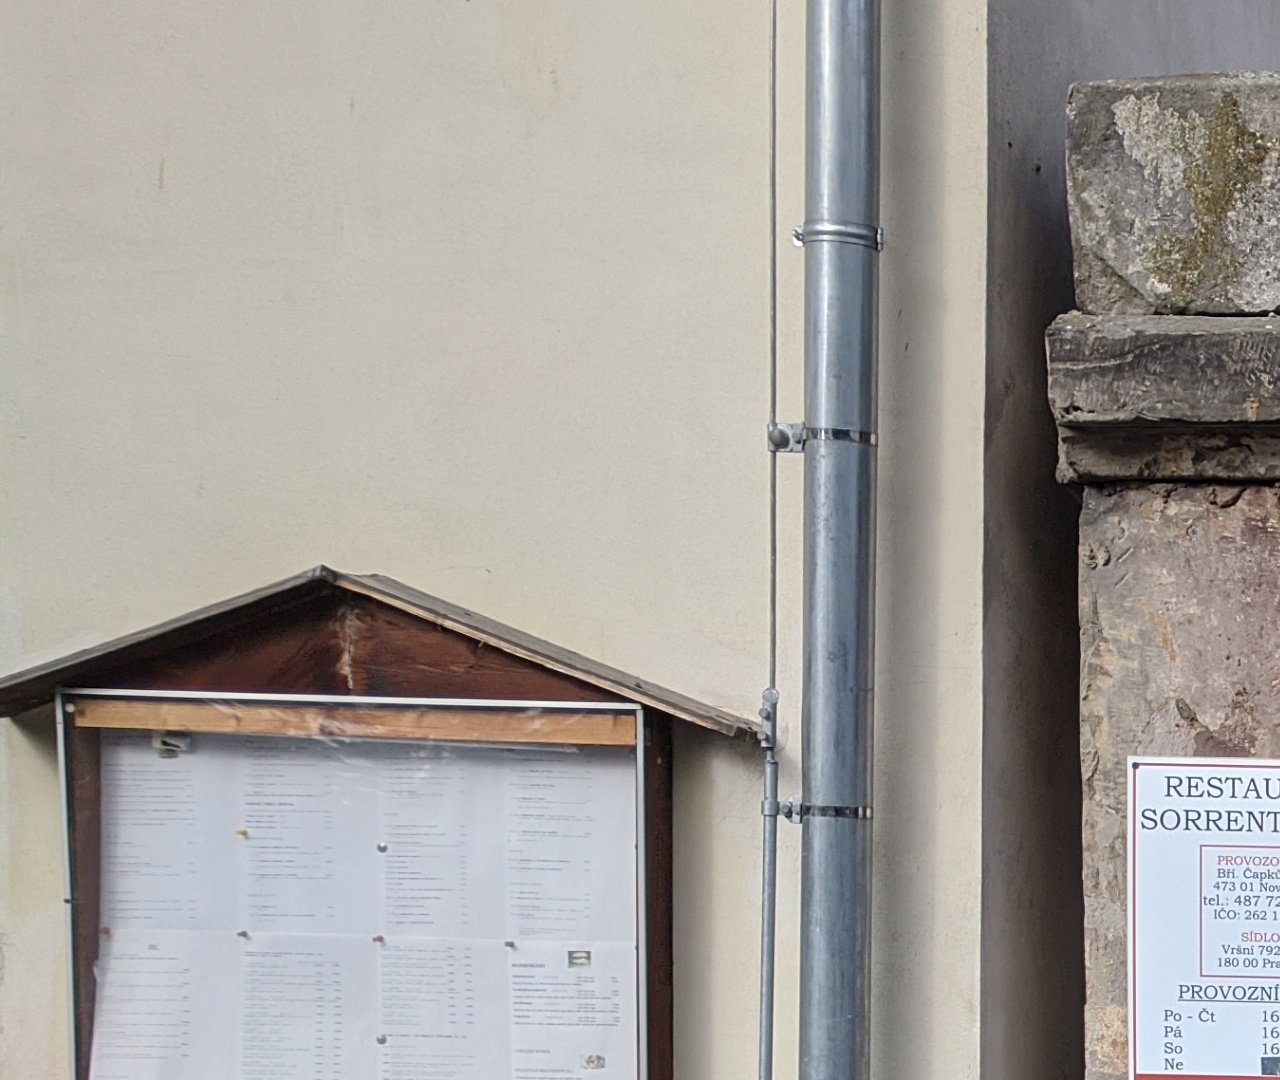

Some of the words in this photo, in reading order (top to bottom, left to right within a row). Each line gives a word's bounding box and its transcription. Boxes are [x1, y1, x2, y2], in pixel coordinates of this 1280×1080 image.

[1213, 882, 1236, 891] 473
[1240, 882, 1254, 892] 01
[1203, 895, 1229, 906] tel.:
[1234, 895, 1261, 907] 487
[1214, 908, 1240, 920] IČO:
[1244, 910, 1267, 920] 262
[1221, 944, 1254, 955] Vršní
[1217, 958, 1239, 967] 180
[1244, 958, 1258, 968] 00
[1179, 984, 1279, 1000] PROVOZNÍ
[1164, 1010, 1182, 1022] Po
[1198, 1008, 1216, 1023] Čt
[1164, 1026, 1183, 1038] Pá
[1164, 1043, 1183, 1055] So
[1164, 1059, 1183, 1070] Ne
